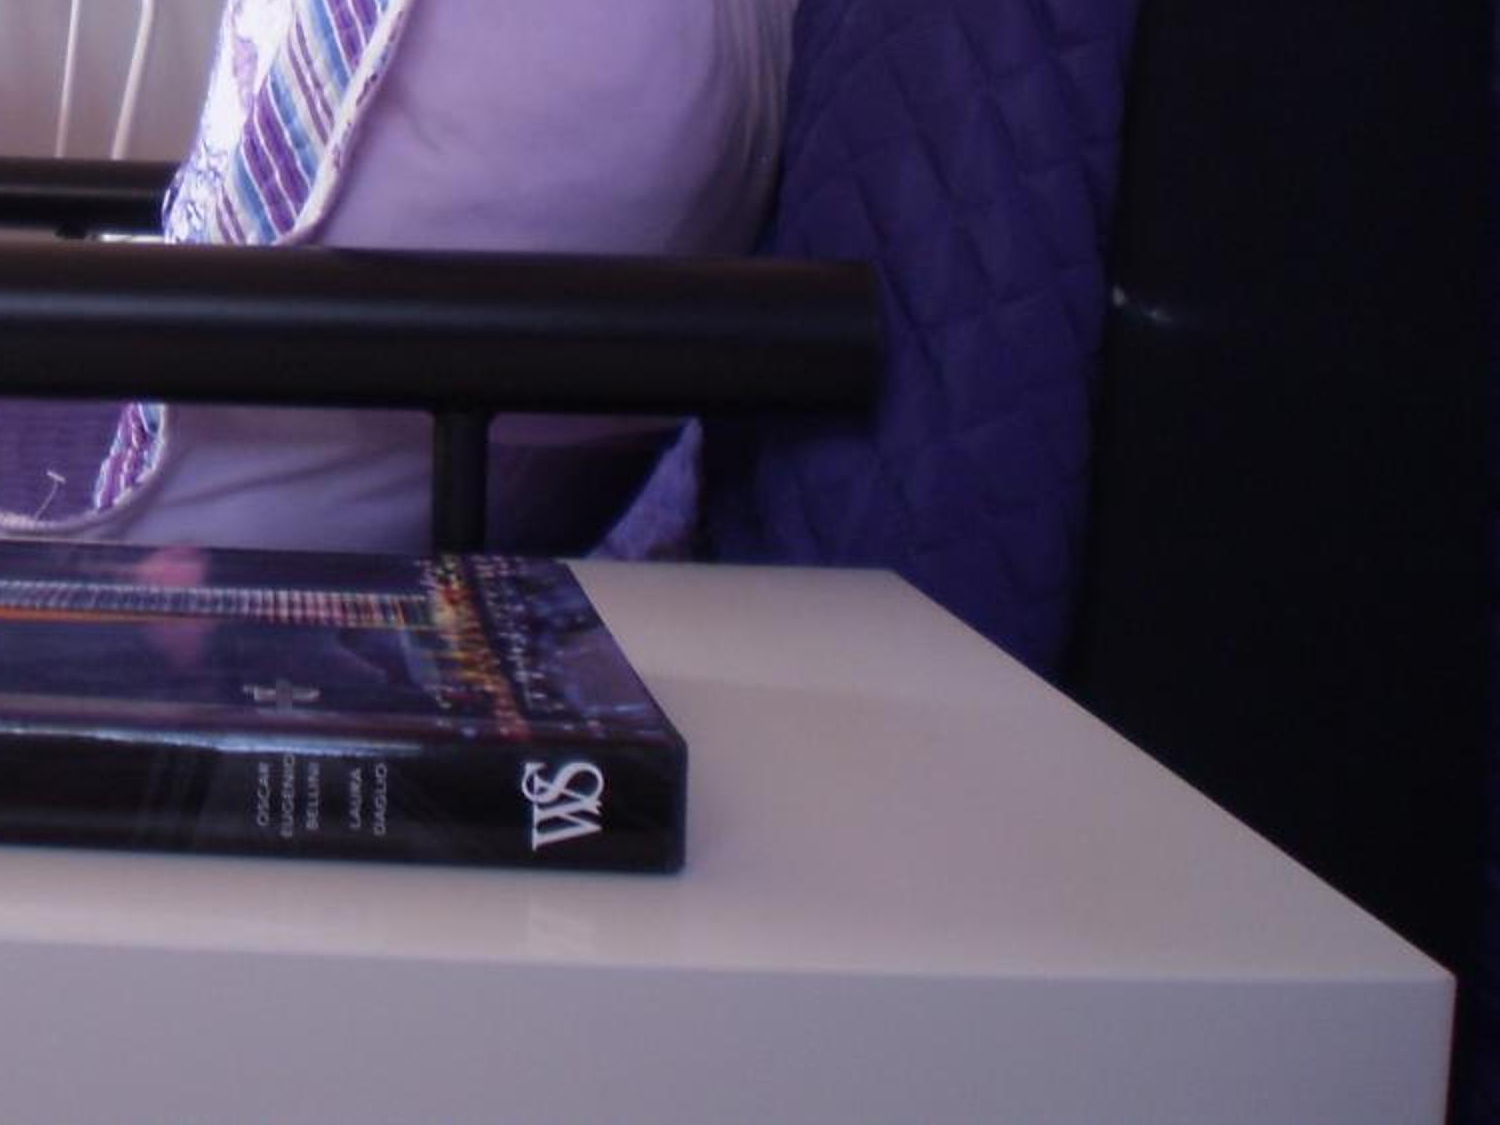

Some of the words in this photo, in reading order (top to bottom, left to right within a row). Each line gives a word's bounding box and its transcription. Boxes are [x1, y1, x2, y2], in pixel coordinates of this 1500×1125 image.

[255, 762, 270, 827] OSCAR
[280, 754, 295, 838] EUGENIO
[305, 761, 321, 830] BELLINI
[350, 767, 362, 829] LAURA
